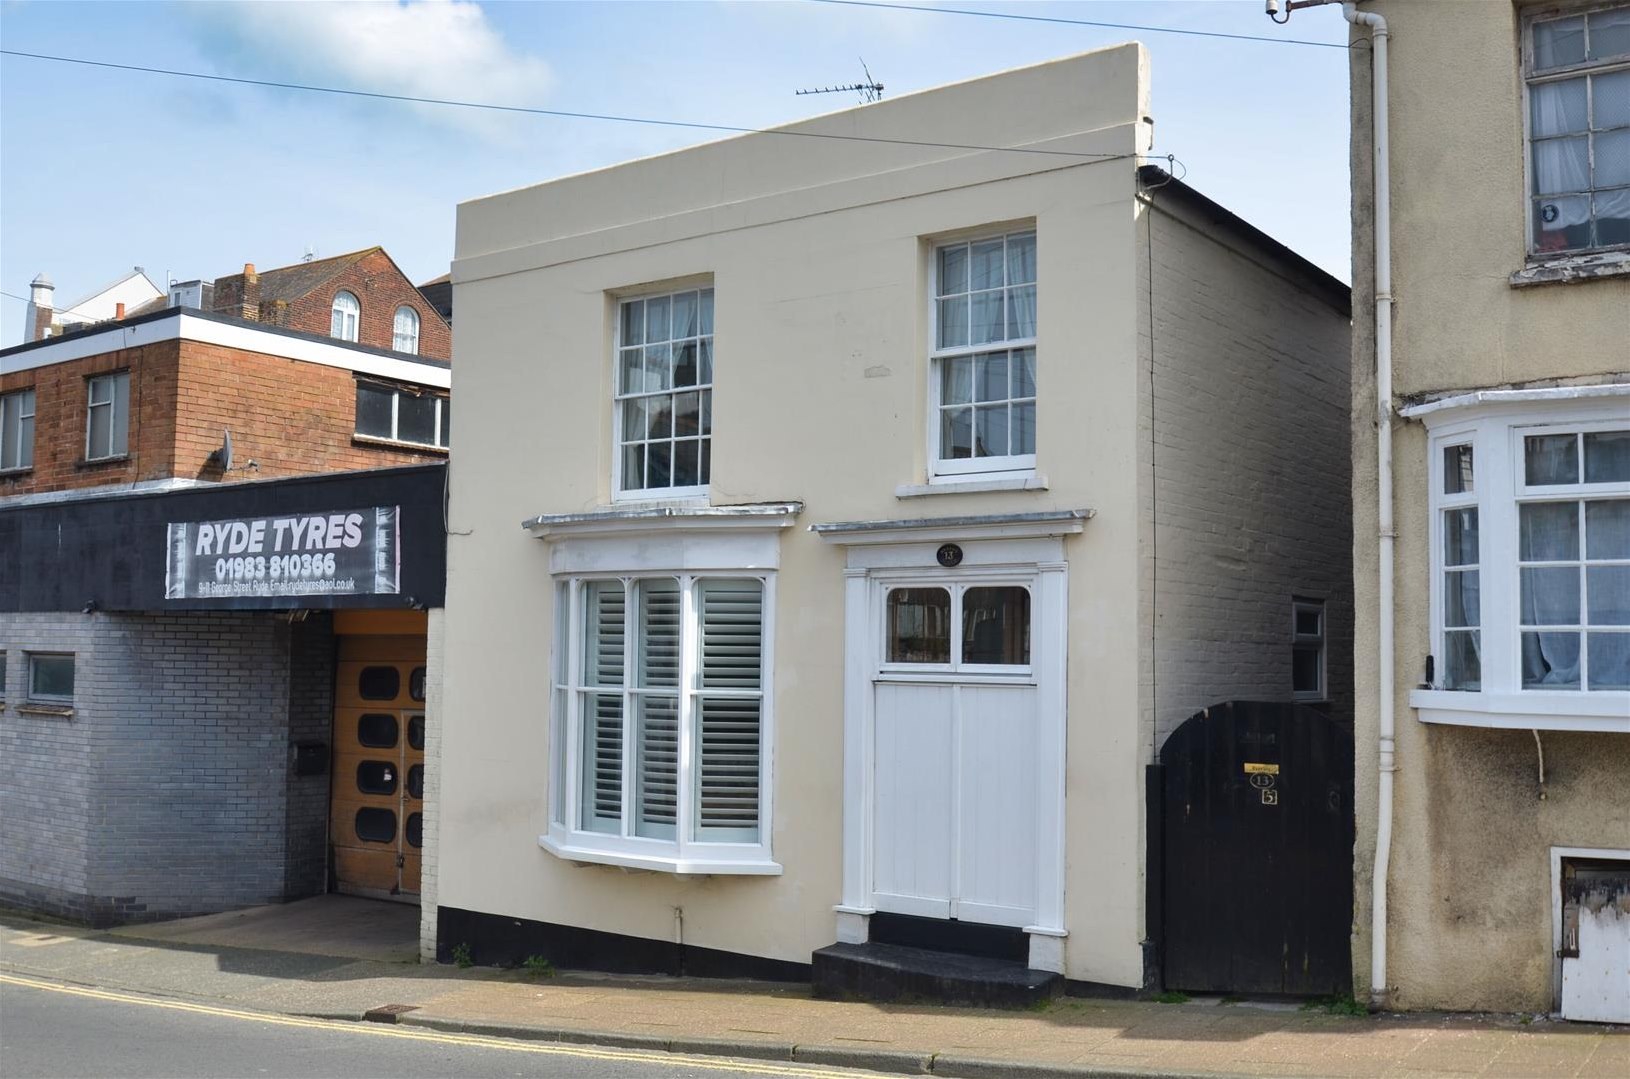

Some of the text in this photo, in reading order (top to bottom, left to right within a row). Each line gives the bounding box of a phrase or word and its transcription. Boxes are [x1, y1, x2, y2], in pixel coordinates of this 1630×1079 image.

[195, 513, 364, 556] RYDE TYRES
[215, 552, 336, 579] 01983 810366
[211, 581, 232, 595] George
[233, 580, 252, 592] Street
[253, 579, 269, 594] Ryde
[1257, 776, 1269, 786] 13
